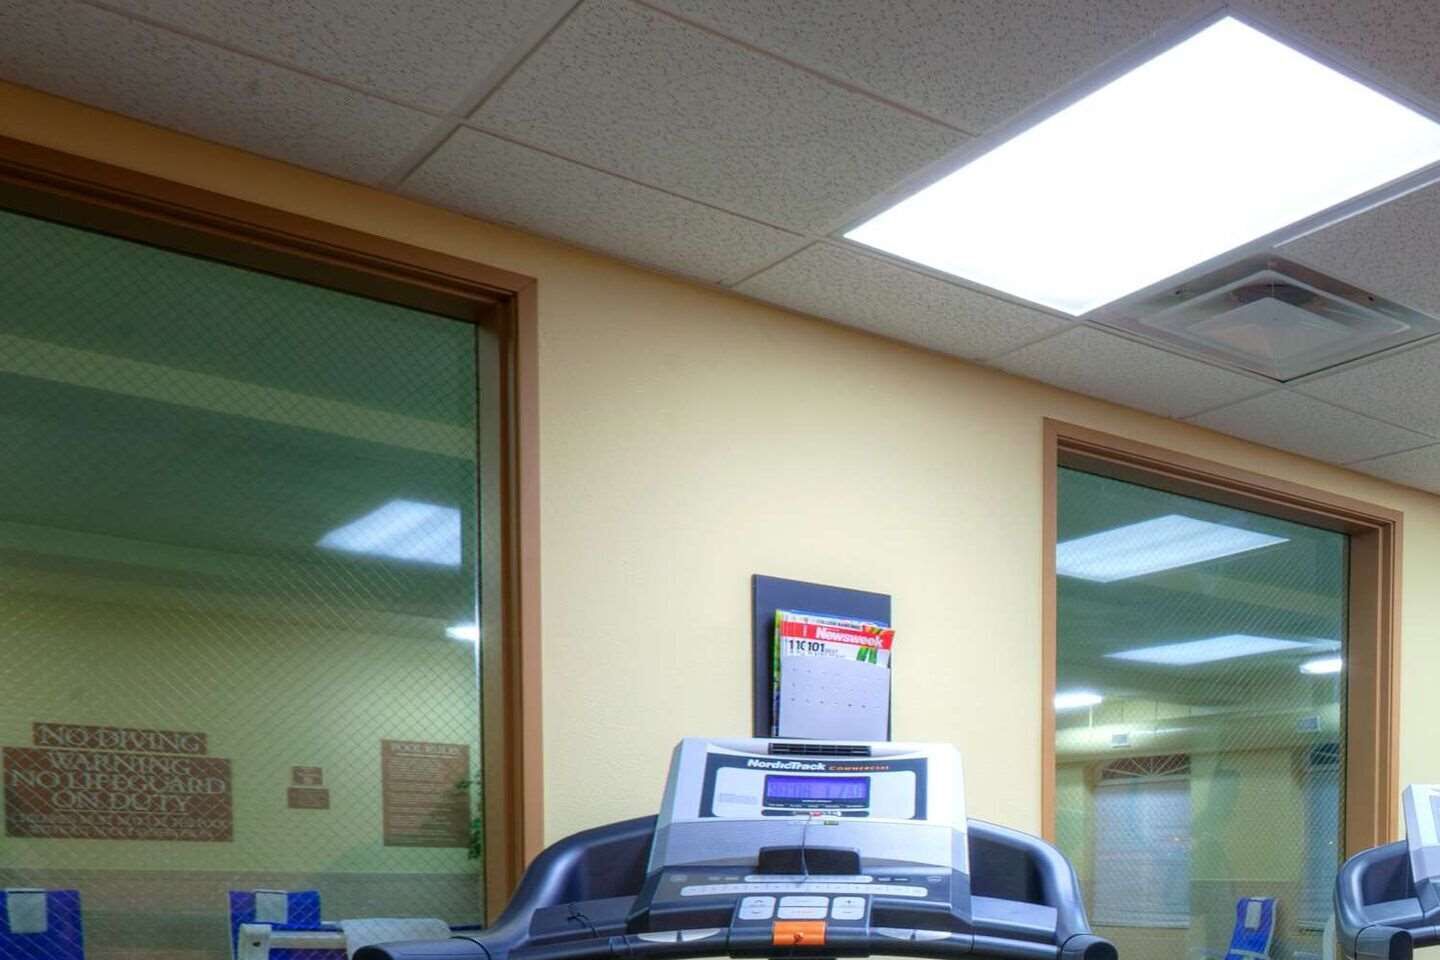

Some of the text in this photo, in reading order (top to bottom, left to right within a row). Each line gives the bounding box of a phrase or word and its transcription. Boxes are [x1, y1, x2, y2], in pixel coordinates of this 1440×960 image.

[816, 627, 883, 648] Newsweek
[39, 724, 201, 752] NO DIVING
[48, 751, 192, 775] WARNING
[747, 759, 826, 771] NordicTrack
[11, 769, 226, 794] NO LIFEGUARD
[52, 789, 191, 812] ON DUTY
